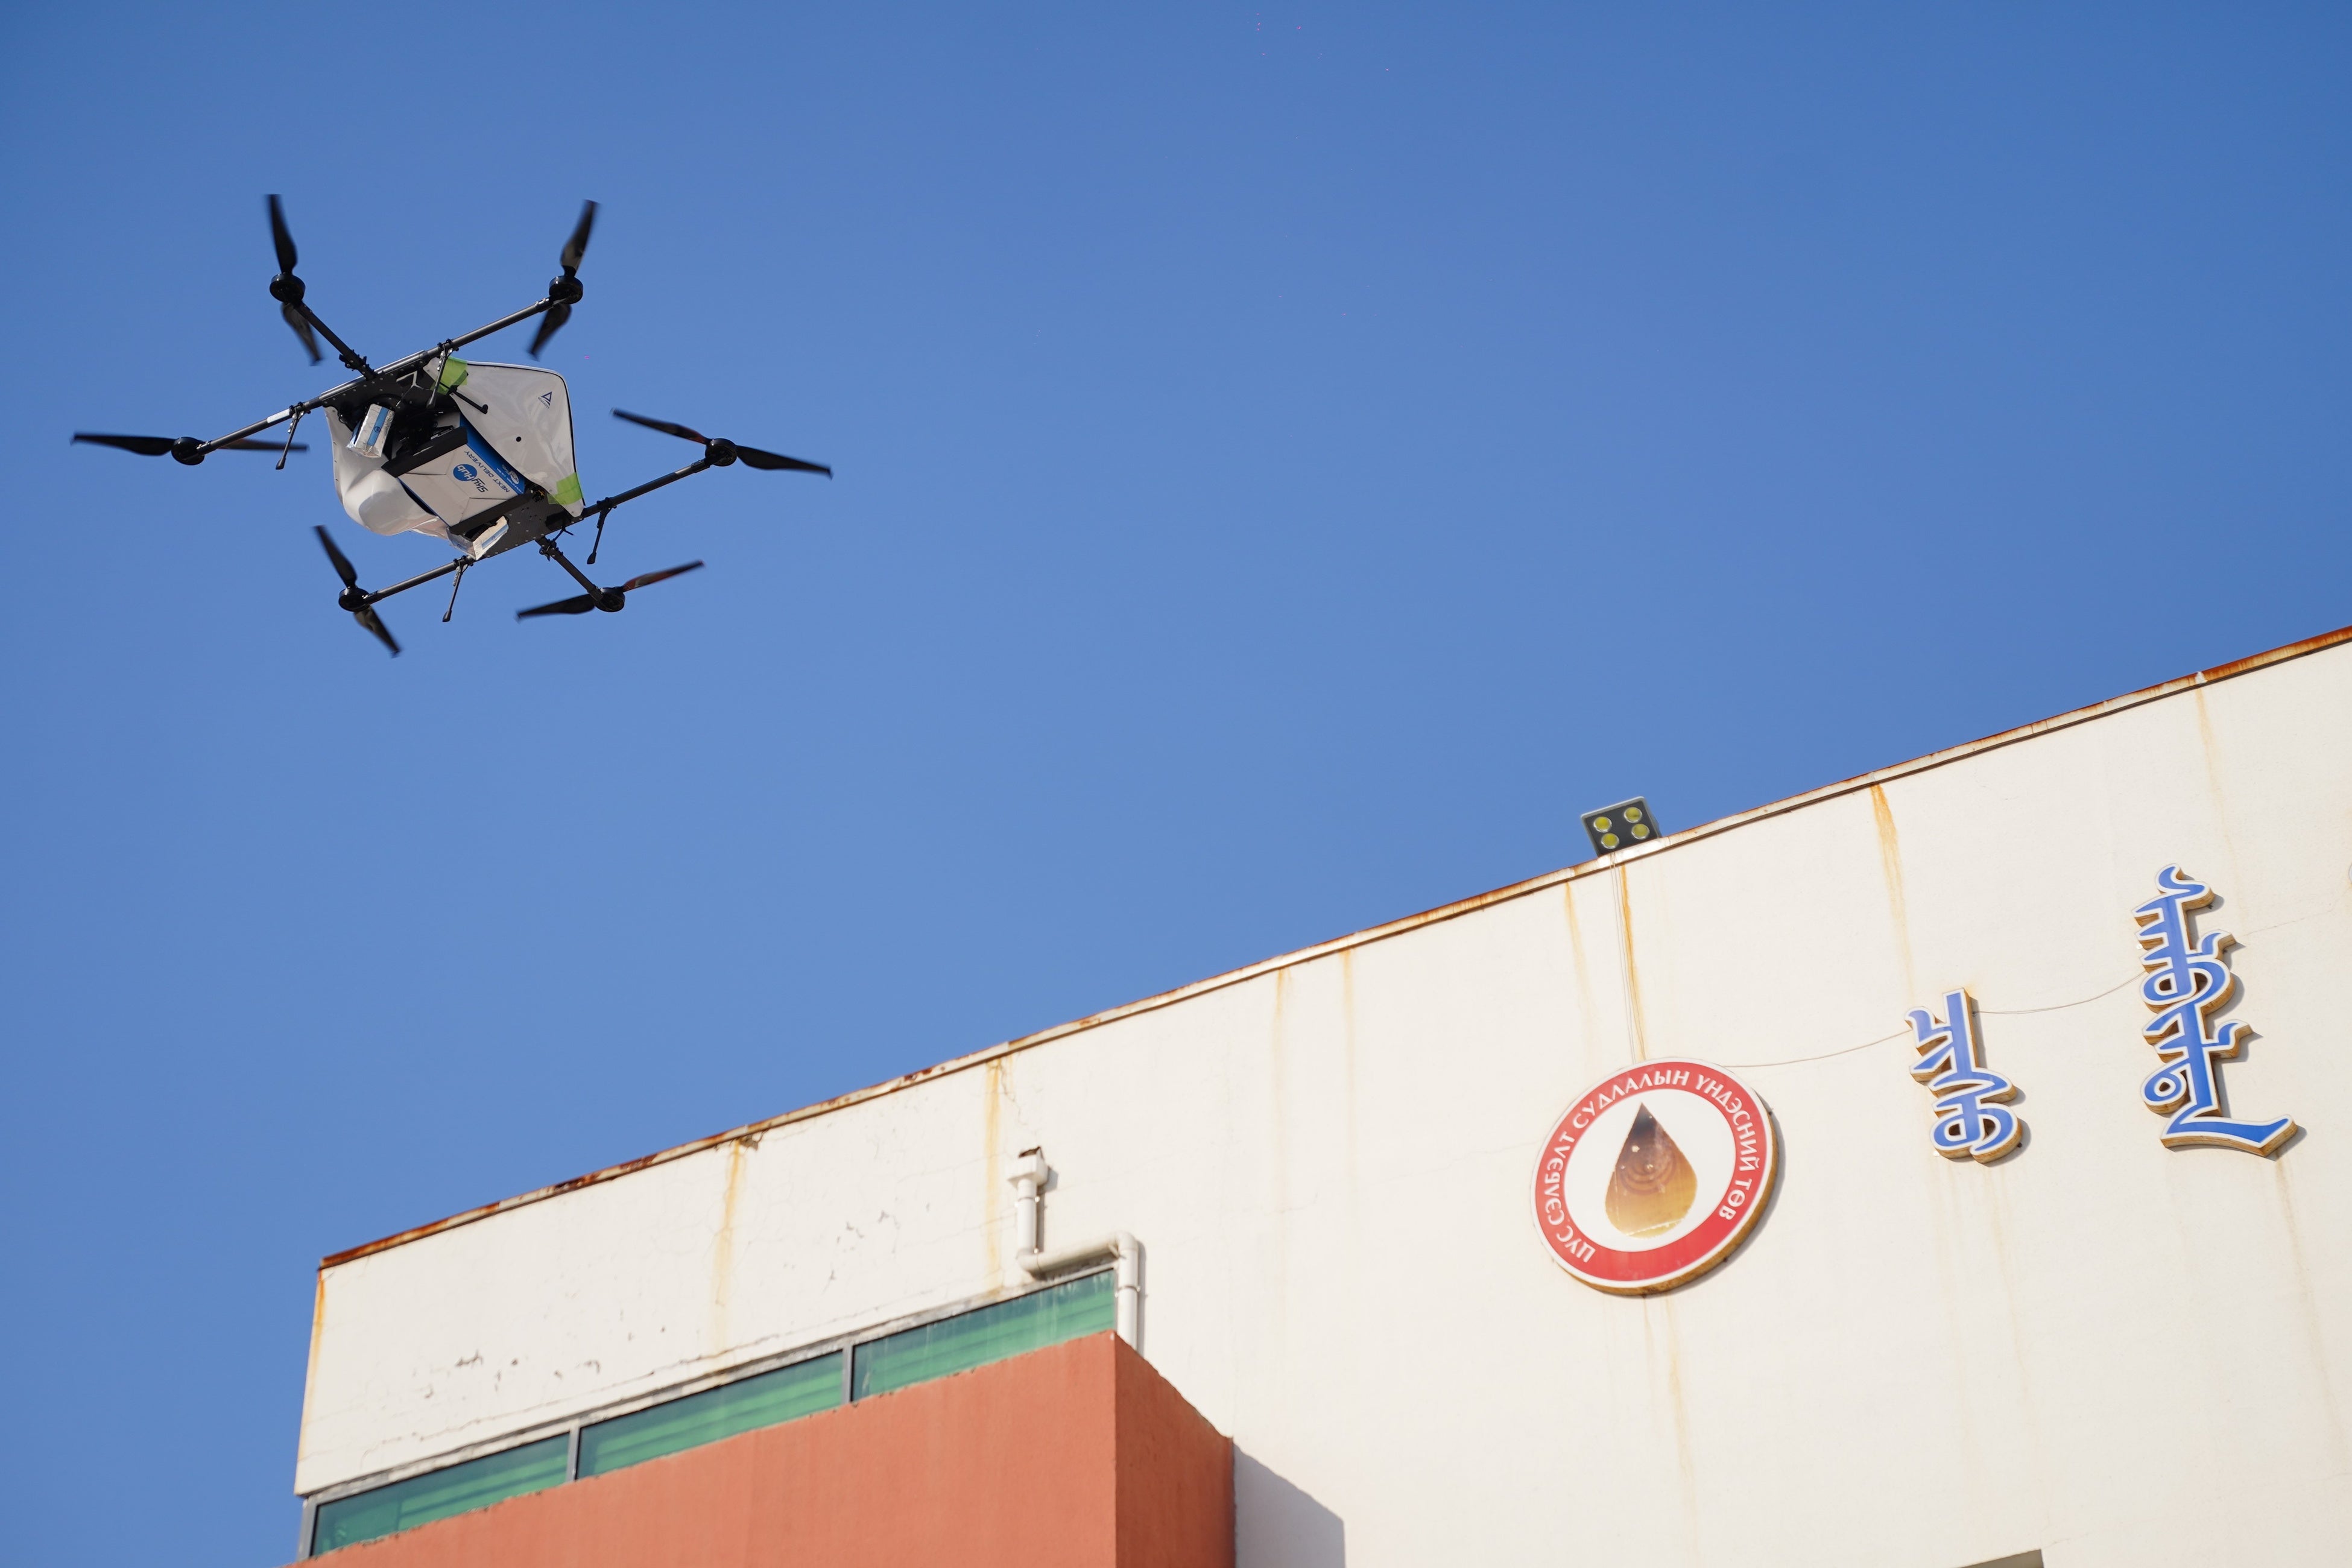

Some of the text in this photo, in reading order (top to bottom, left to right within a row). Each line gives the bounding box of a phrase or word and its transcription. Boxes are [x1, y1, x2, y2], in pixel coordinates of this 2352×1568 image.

[464, 450, 494, 478] DELIVERY
[493, 479, 510, 493] NEXT
[1544, 1070, 1759, 1263] ЦУС СЭЛБЭЛТ СУДЛАЛЫН ҮНДЭСНИЙ ТӨВ
